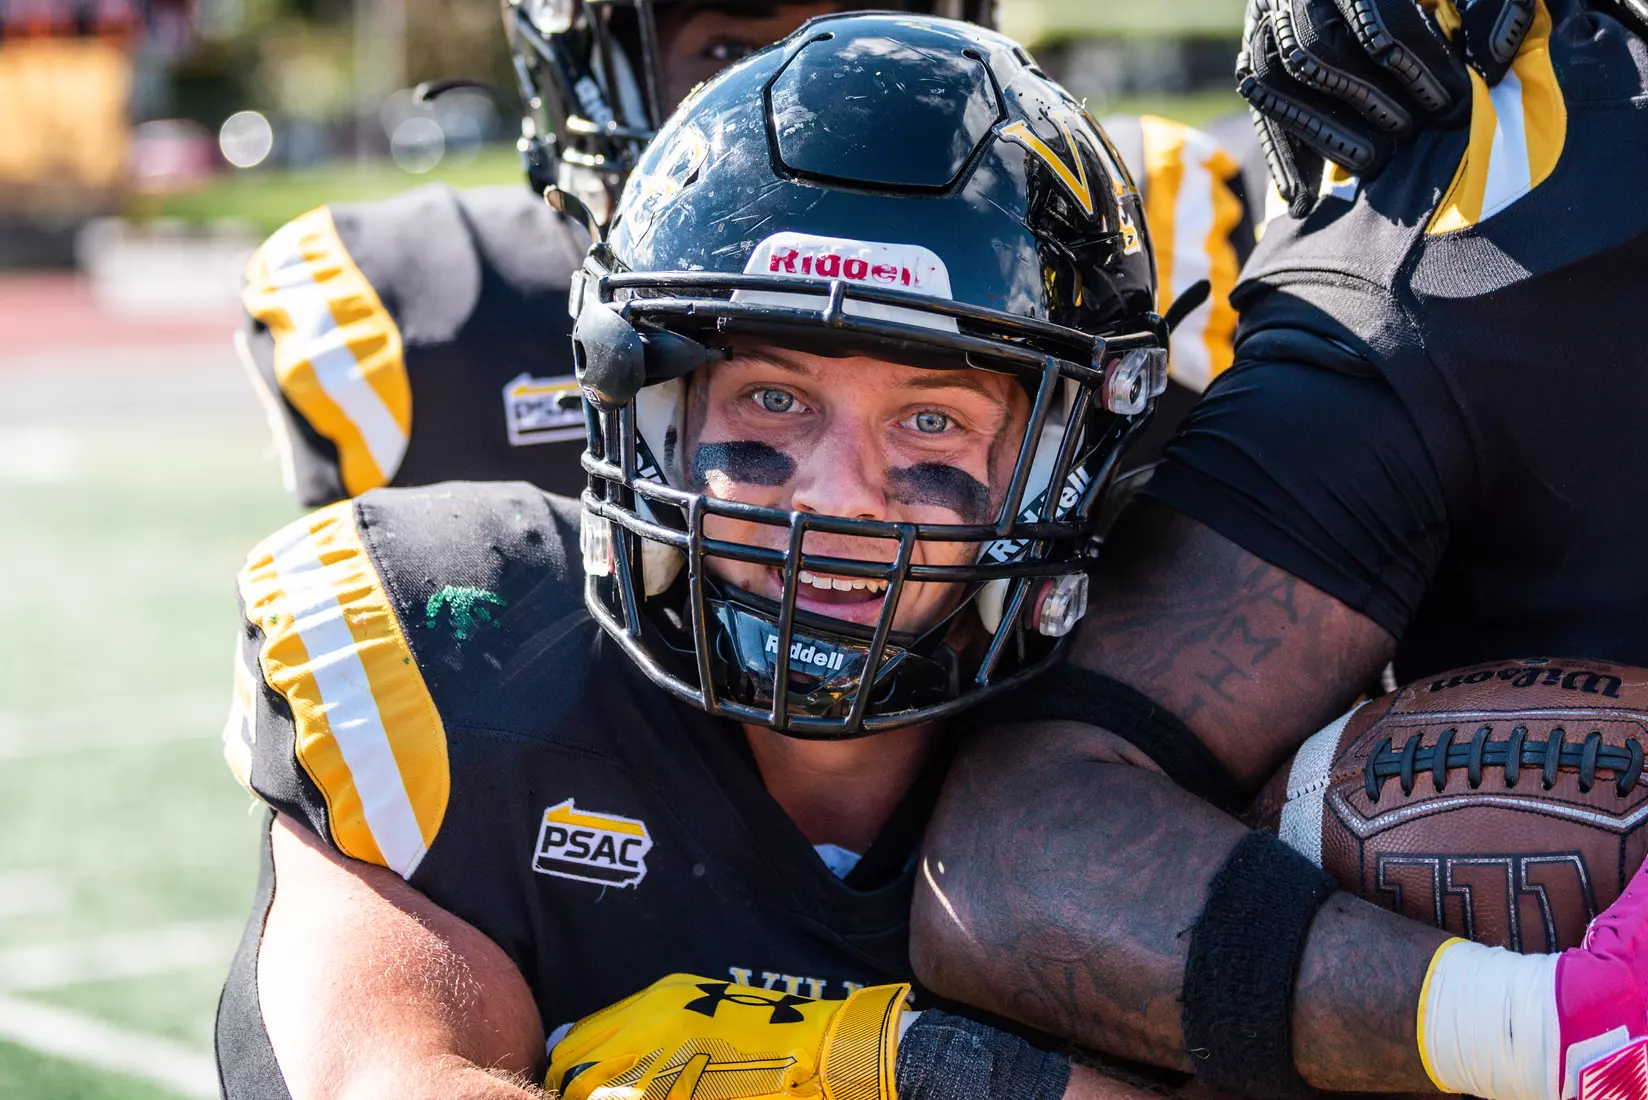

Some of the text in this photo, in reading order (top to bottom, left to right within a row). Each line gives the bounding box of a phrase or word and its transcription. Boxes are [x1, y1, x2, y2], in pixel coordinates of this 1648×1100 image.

[988, 466, 1091, 562] Rell
[765, 634, 844, 670] Rddell
[1429, 665, 1622, 698] Wilson
[541, 825, 642, 868] PSAC
